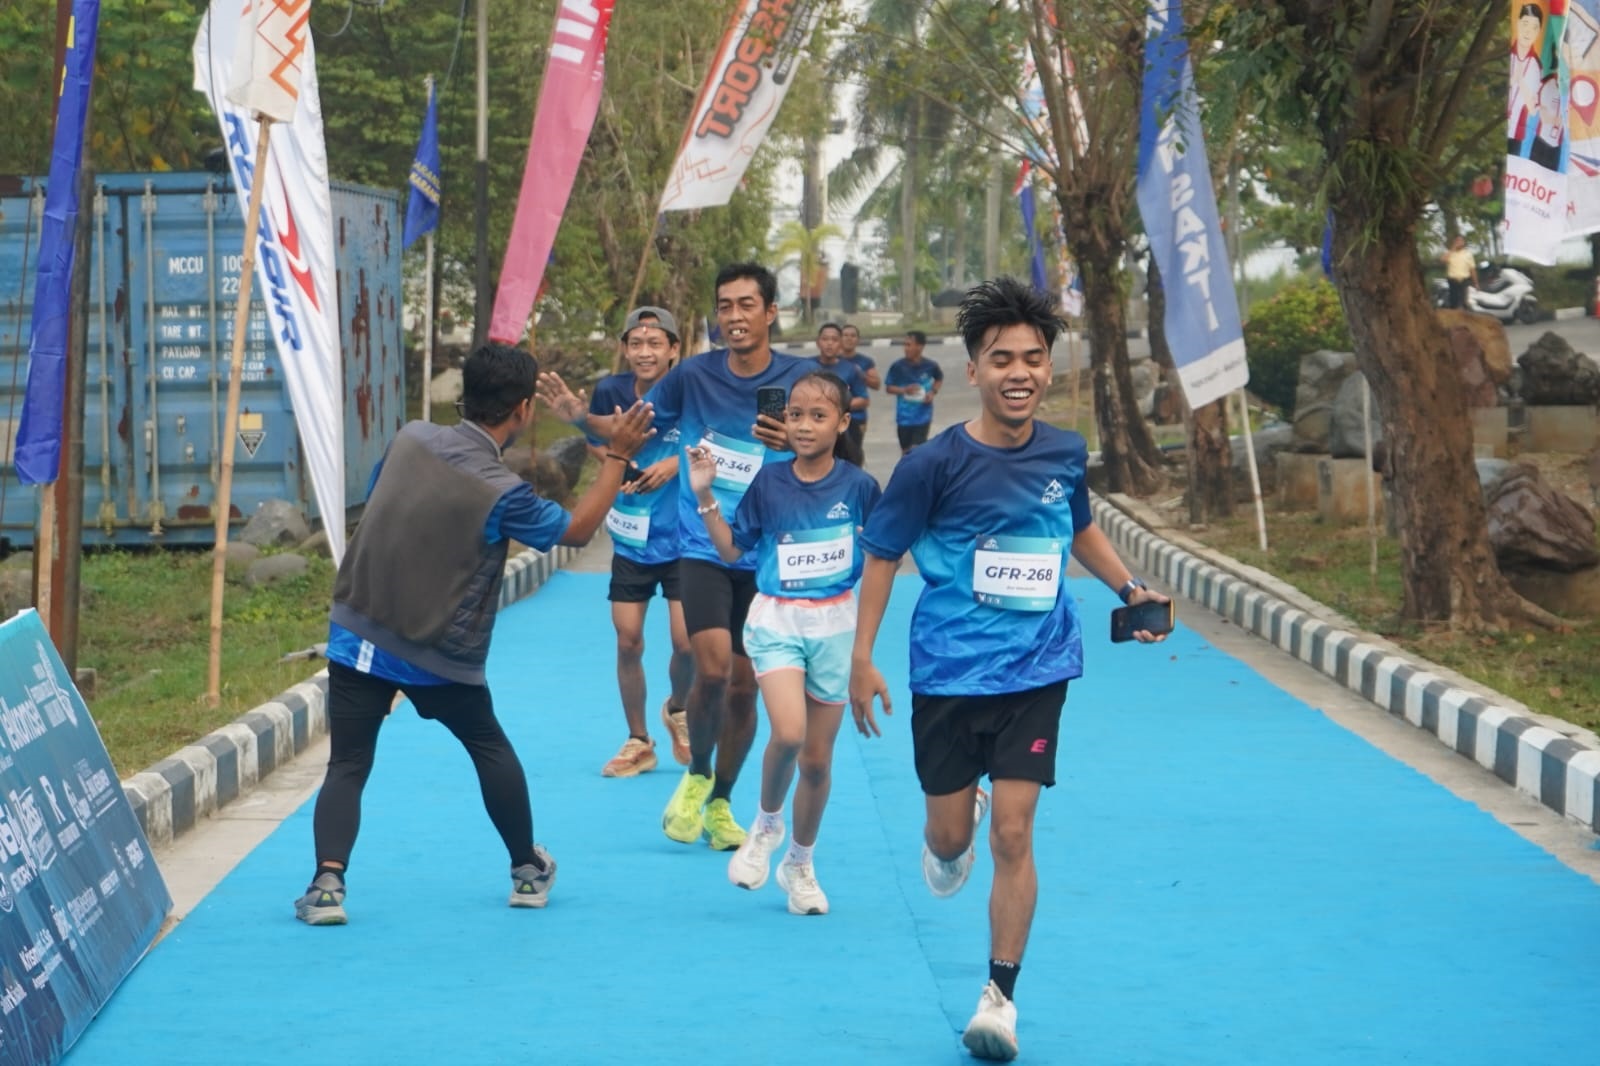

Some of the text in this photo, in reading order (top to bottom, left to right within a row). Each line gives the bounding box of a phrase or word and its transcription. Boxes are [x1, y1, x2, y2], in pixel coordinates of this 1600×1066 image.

[168, 256, 204, 274] MCCU
[161, 326, 182, 338] TARE
[162, 346, 201, 359] PAYLOAD
[786, 549, 846, 567] GFR-348
[985, 566, 1053, 582] GFR-268
